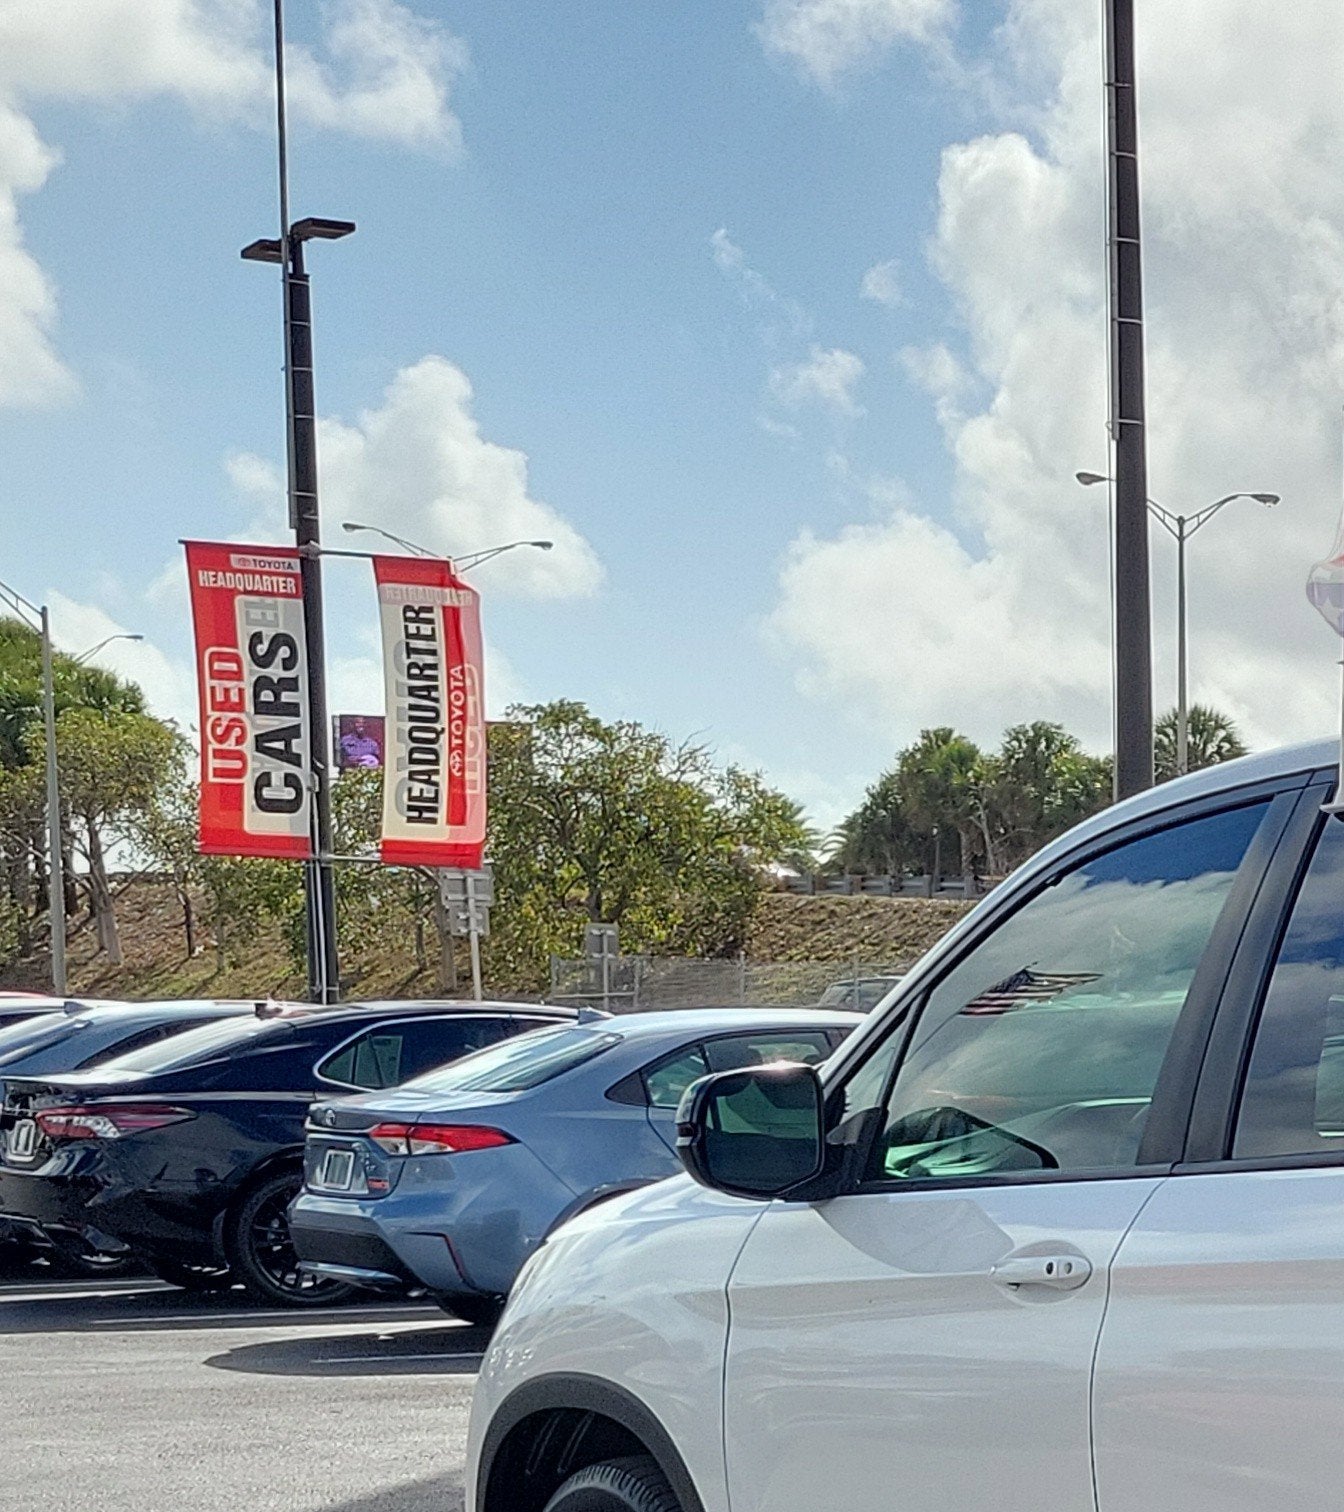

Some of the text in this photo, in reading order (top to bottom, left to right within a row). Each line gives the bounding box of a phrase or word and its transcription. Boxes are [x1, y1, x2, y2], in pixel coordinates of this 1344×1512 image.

[198, 570, 296, 594] HEADQUARTER
[252, 558, 294, 571] TOYOTA
[205, 647, 248, 784] USED
[249, 630, 304, 815] CARS
[403, 605, 440, 825] HEADQUARTER
[450, 665, 464, 746] TOYOTA
